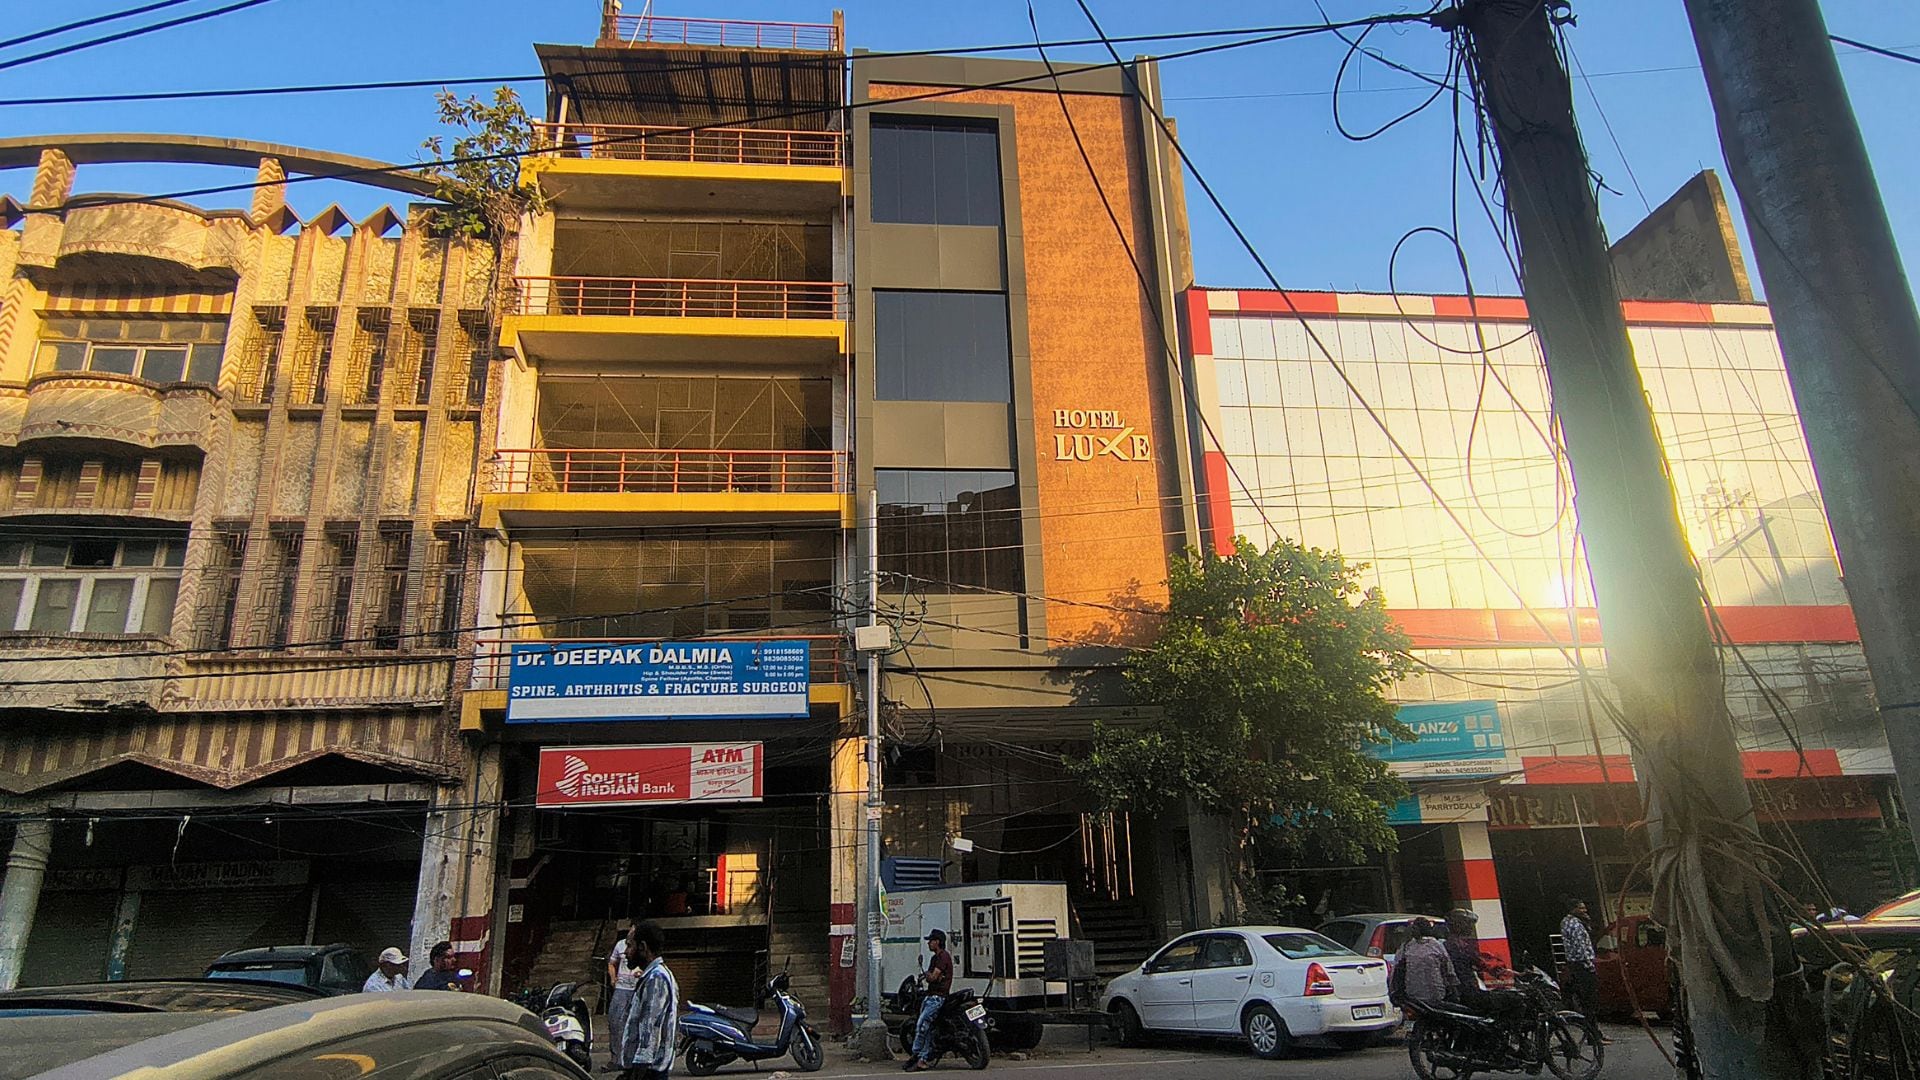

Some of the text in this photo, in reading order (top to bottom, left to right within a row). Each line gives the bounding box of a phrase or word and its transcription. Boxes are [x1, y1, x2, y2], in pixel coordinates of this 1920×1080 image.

[1053, 409, 1125, 429] HOTEL
[1054, 427, 1151, 462] LUXE
[517, 647, 733, 666] Dr. DEEPAK DALMIA
[564, 684, 643, 696] ARTHRITIS
[647, 683, 660, 695] &
[664, 682, 739, 694] FRACTURE
[742, 681, 807, 693] SURGEON
[1401, 720, 1459, 735] LANZO
[702, 748, 744, 763] ATM
[582, 772, 640, 785] SOUTH
[581, 782, 675, 797] INDIAN Bank
[1425, 802, 1481, 811] PARRYDEALS
